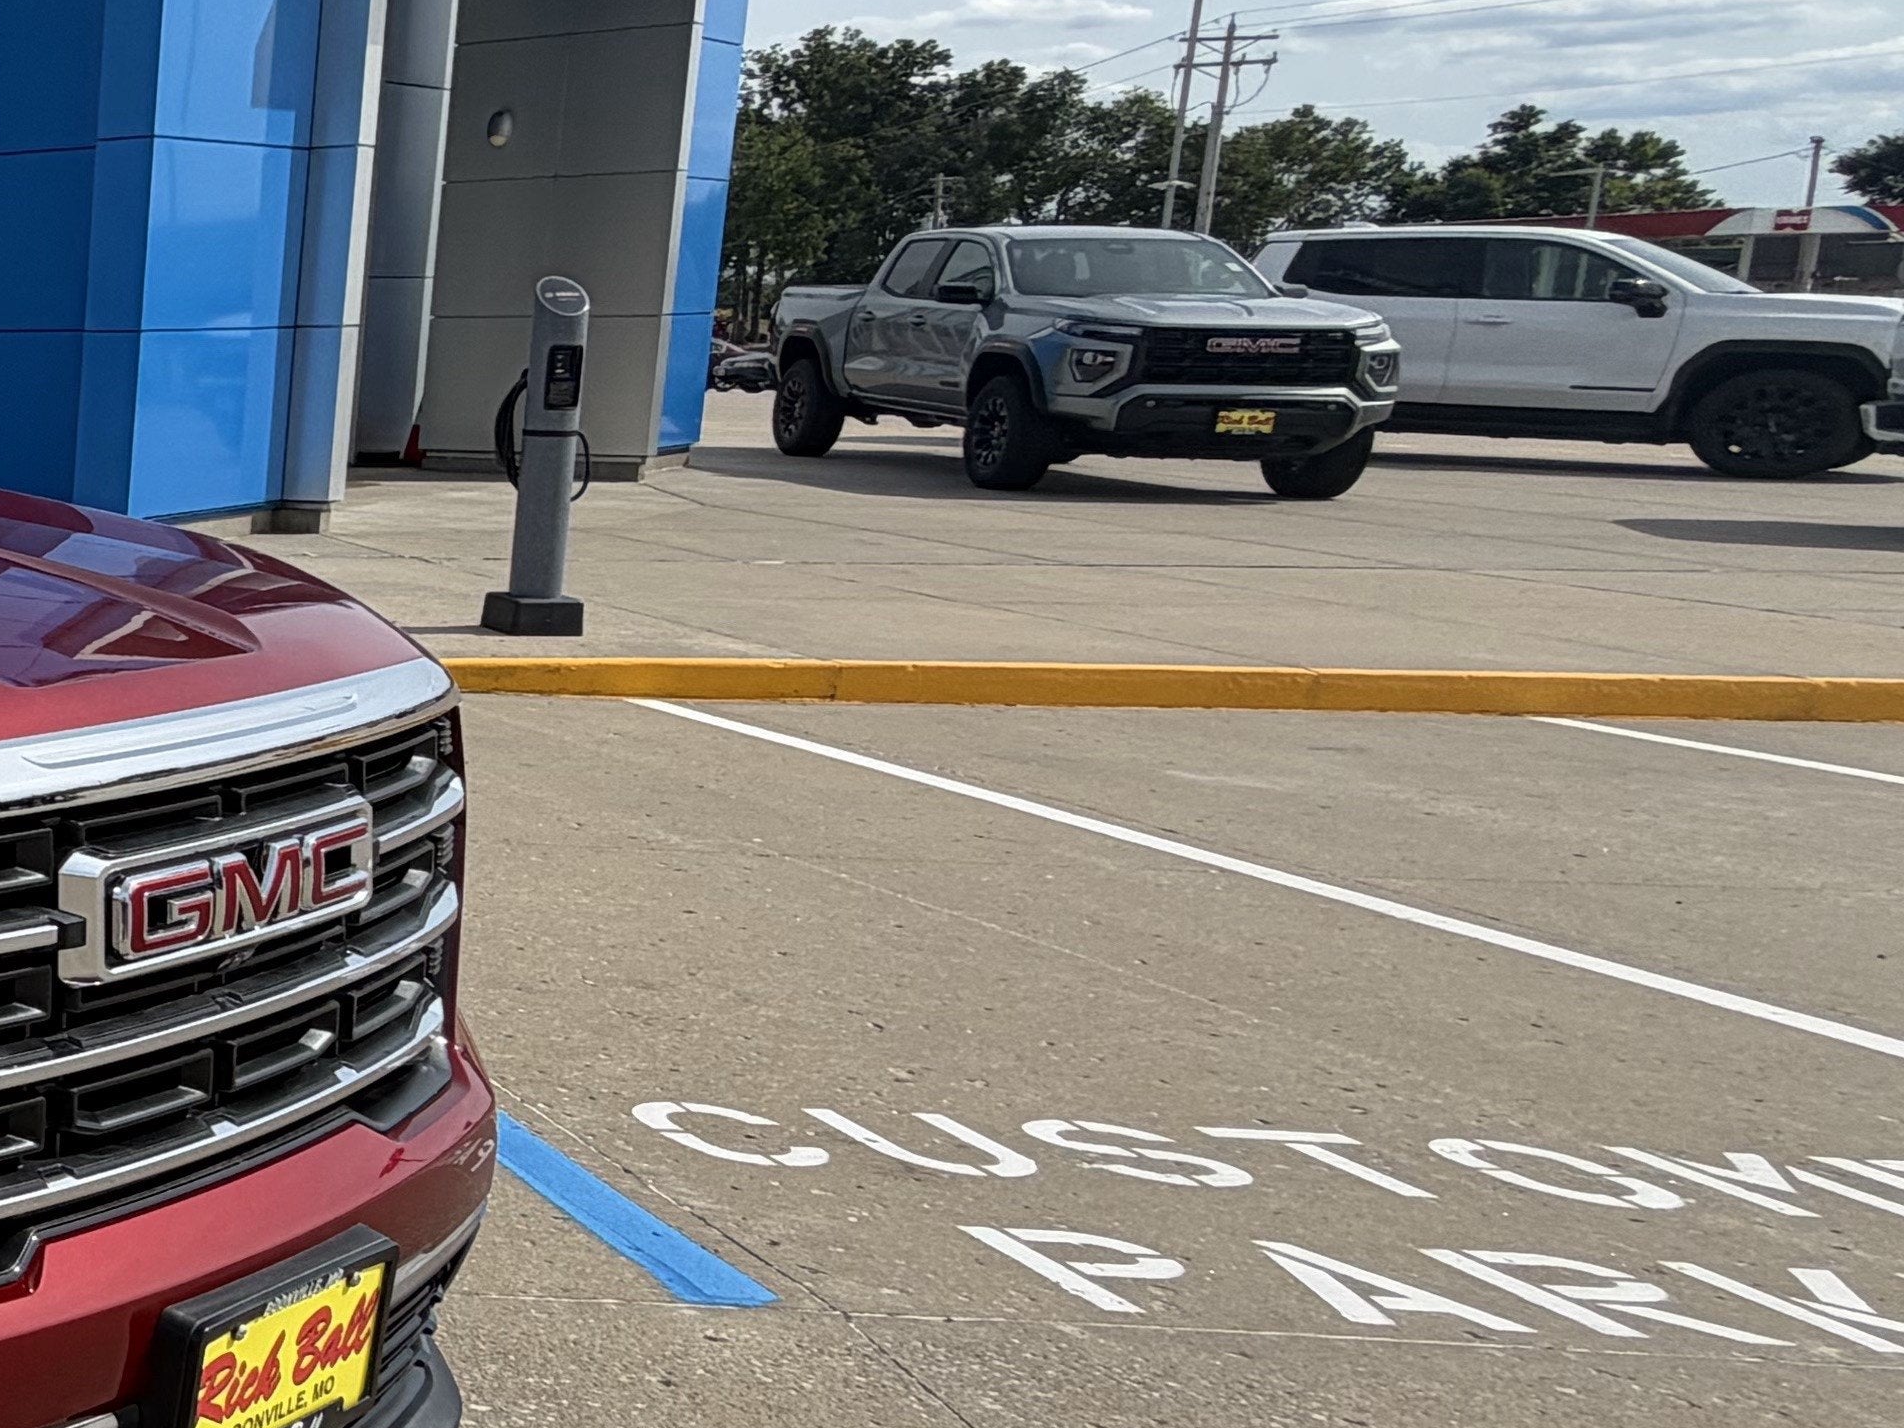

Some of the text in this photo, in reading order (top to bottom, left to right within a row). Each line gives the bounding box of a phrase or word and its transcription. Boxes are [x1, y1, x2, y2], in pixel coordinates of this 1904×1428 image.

[1206, 337, 1302, 353] GMC
[116, 817, 369, 958] GMC
[630, 1098, 1904, 1218] CUSTOM
[959, 1223, 1904, 1355] PARK
[196, 1329, 286, 1423] Rick
[292, 1286, 380, 1386] Ball
[312, 1375, 335, 1403] MO
